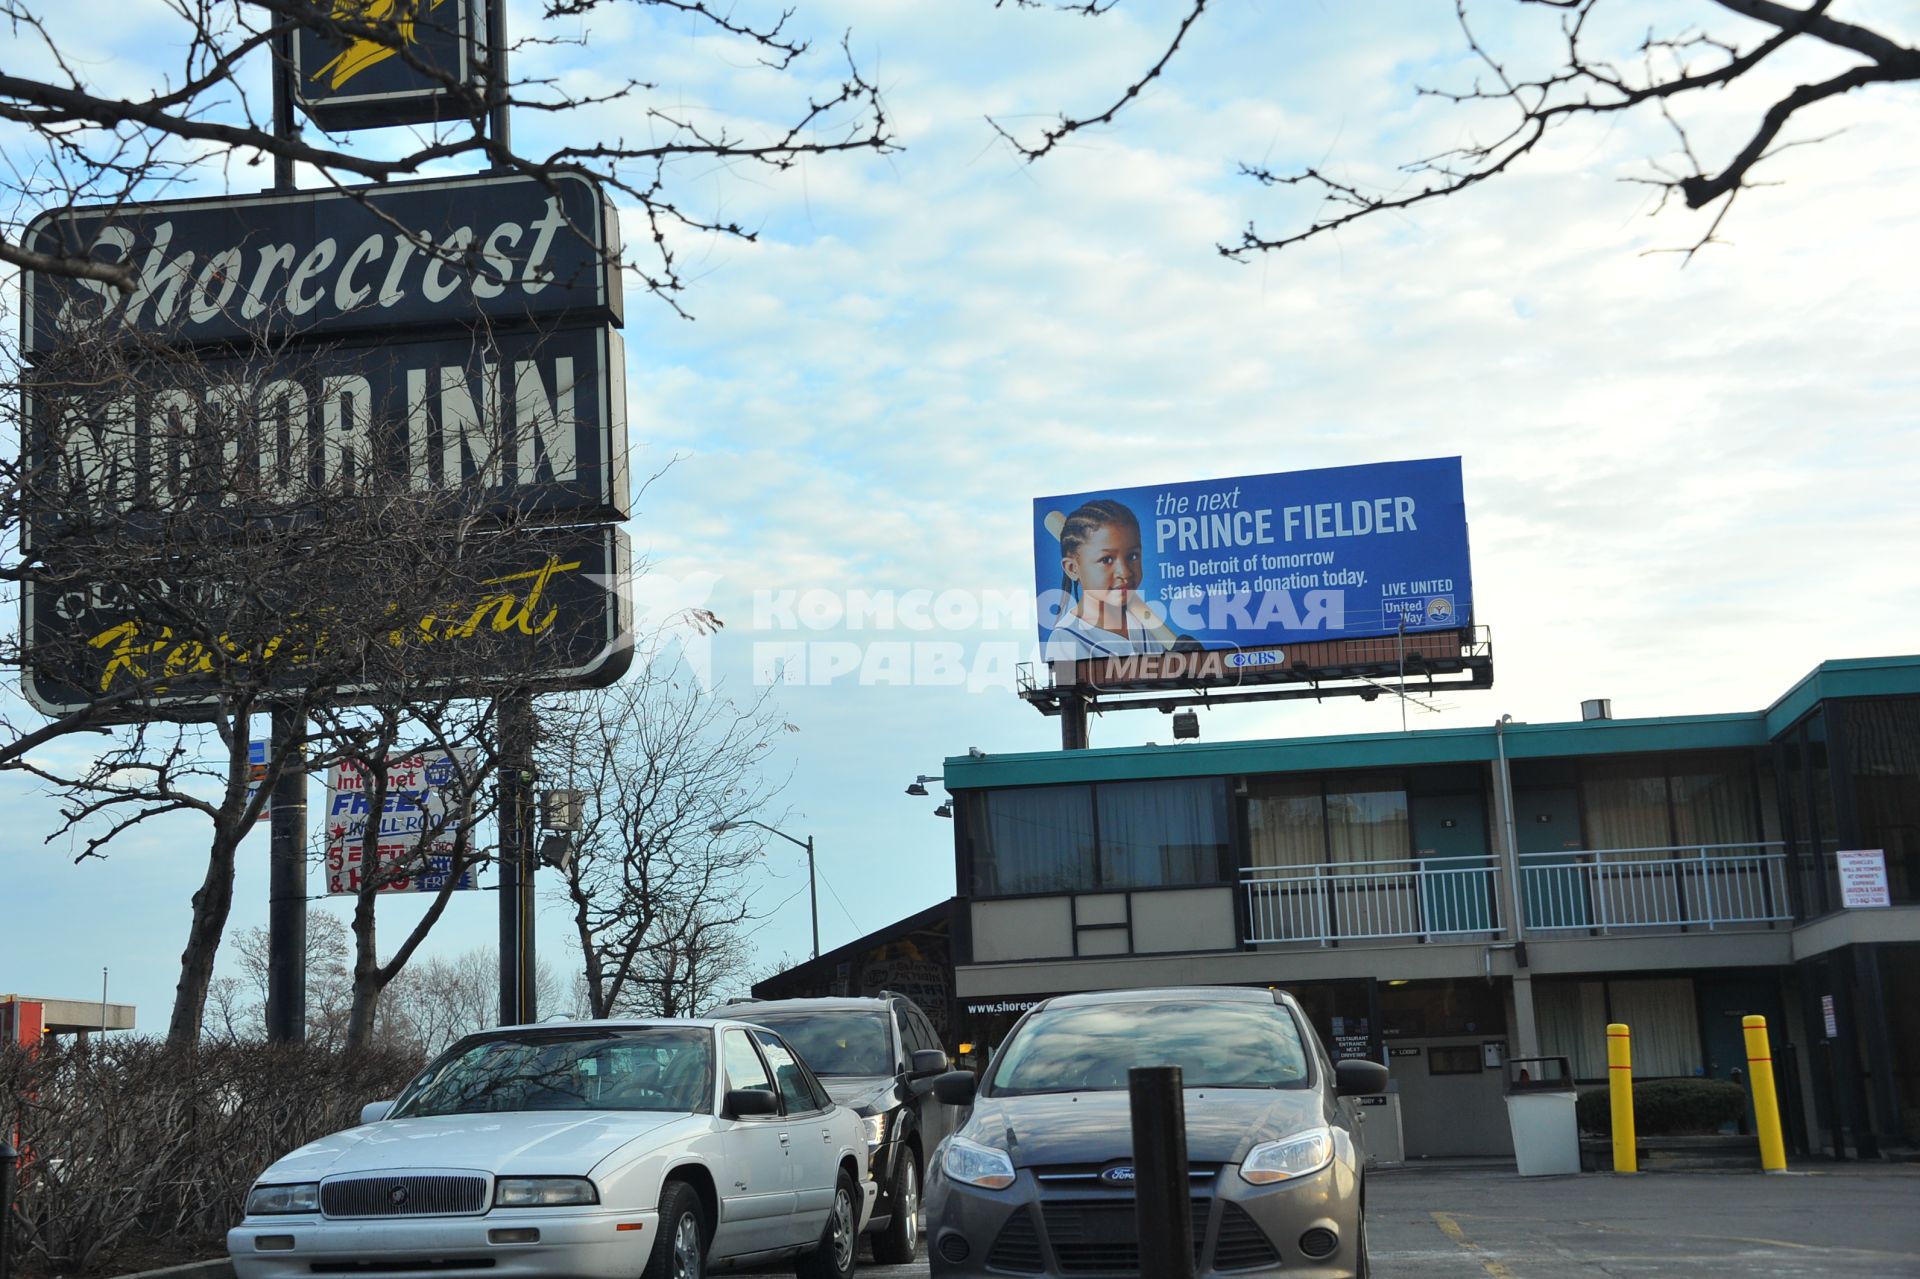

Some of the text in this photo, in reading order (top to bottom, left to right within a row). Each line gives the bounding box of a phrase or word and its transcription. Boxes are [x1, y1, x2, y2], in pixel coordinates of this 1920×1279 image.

[55, 196, 570, 330] Shorecrest
[57, 357, 577, 518] MOTOR INN
[1155, 486, 1241, 516] the next
[1156, 496, 1418, 553] PRINCE FIELDER
[1159, 551, 1335, 579] The Detroit of tomorrow
[1160, 567, 1368, 601] starts with a donation today.
[1382, 579, 1453, 597] LIVE UNITED
[1384, 600, 1423, 613] United
[1400, 612, 1423, 625] Way
[1247, 651, 1276, 665] CBS
[337, 773, 417, 790] Intnet
[328, 846, 344, 871] 5
